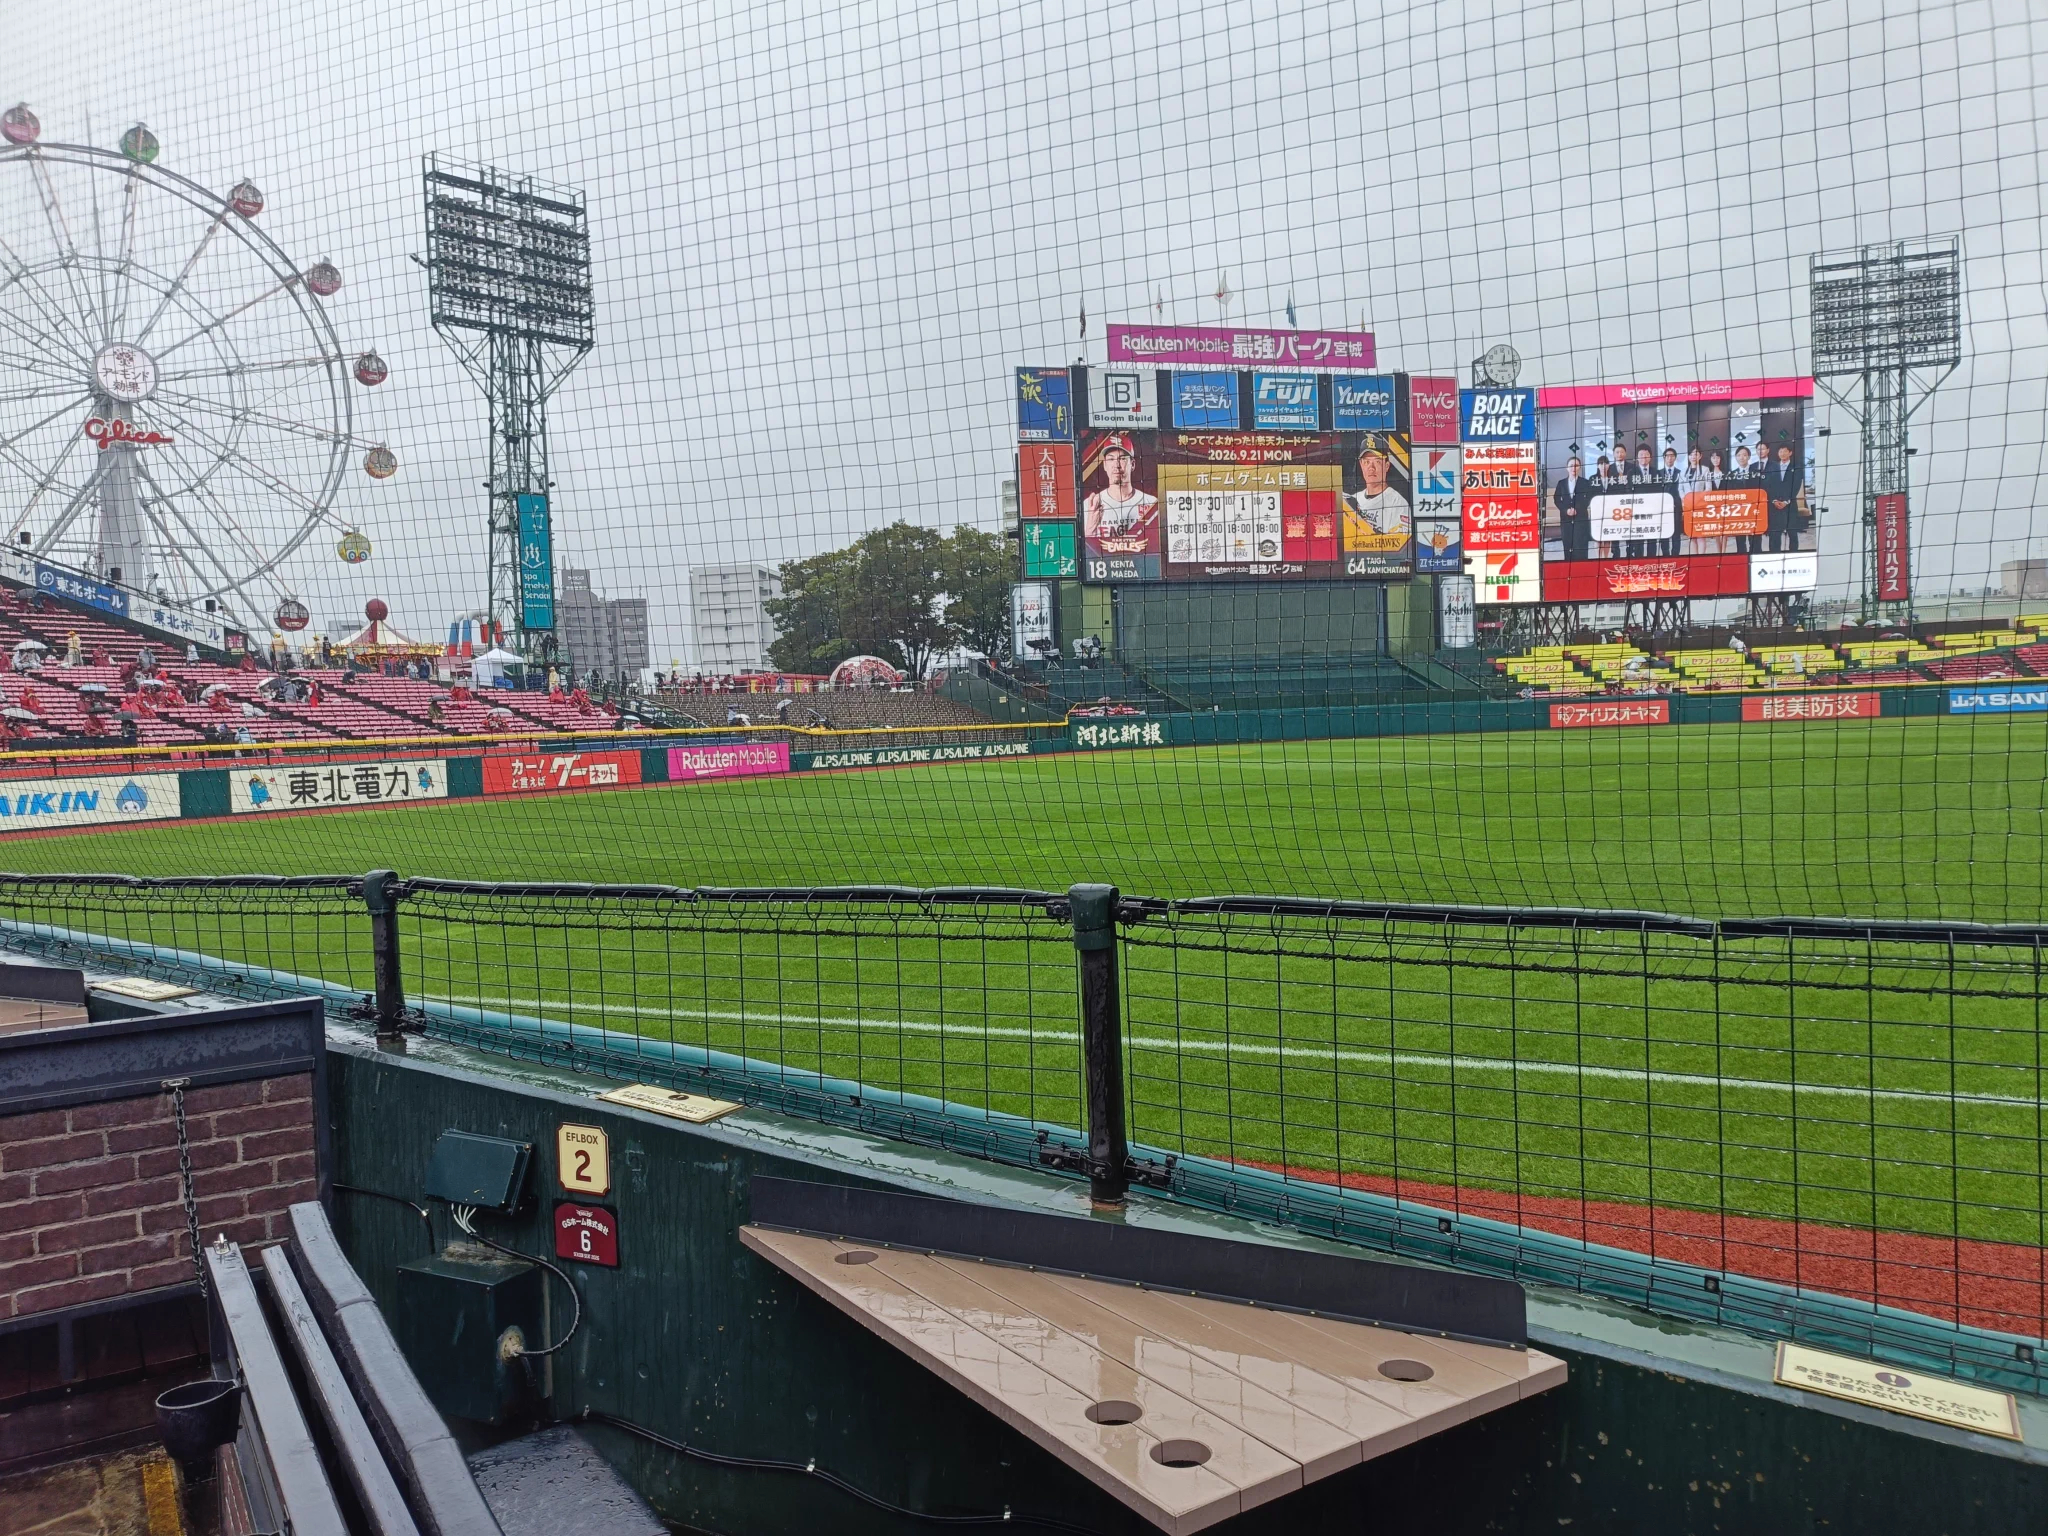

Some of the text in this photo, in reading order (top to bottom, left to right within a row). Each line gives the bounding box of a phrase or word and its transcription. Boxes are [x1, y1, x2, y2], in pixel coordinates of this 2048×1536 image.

[1121, 334, 1183, 354] Rakuten
[1185, 337, 1230, 353] Mobile
[102, 367, 150, 382] アーモンド
[113, 381, 141, 393] 効果
[1258, 377, 1314, 405] Fuji
[1621, 384, 1732, 400] Rakuten Mobile Vision
[1337, 385, 1390, 406] Yurtec
[1412, 391, 1455, 410] TWG
[1338, 408, 1390, 416] 株式会社 ユアテック
[1473, 394, 1527, 415] BOAT
[1094, 414, 1153, 422] Bloom Build
[1435, 412, 1451, 420] Work
[1469, 416, 1523, 435] RACE
[85, 418, 175, 450] Glico
[1207, 450, 1292, 461] 2026.9.21 MON
[1038, 447, 1057, 515] 大和証券
[1196, 471, 1307, 486] ホームゲーム日程
[1465, 469, 1534, 488] あいホーム
[1418, 498, 1455, 512] カメイ
[1705, 503, 1752, 519] 3,827
[1206, 513, 1214, 521] 水
[1235, 513, 1243, 521] 木
[1263, 513, 1272, 521] 土
[1469, 502, 1533, 528] Glico
[1612, 508, 1633, 521] 88
[1169, 524, 1194, 534] 18:00
[1198, 524, 1223, 534] 18:00
[1227, 523, 1251, 533] 18:00
[1255, 523, 1279, 533] 18:00
[1703, 521, 1757, 531] 業界トップクラス
[1351, 538, 1400, 549] SoftBank HAWKS
[1470, 531, 1533, 543] 遊びに行こう!
[1025, 524, 1075, 575] 清月記
[1102, 541, 1146, 553] EAGLES
[1884, 501, 1900, 592] 三井のリハウス
[1088, 561, 1107, 579] 18
[1110, 560, 1135, 568] KENTA
[1347, 557, 1366, 575] 64
[524, 574, 538, 582] spa
[1111, 570, 1139, 578] MAEDA
[55, 576, 124, 609] 東北ボール
[525, 591, 551, 600] Sendai
[1444, 602, 1472, 616] Asahi
[153, 609, 220, 641] 東北ボール
[1016, 611, 1049, 626] Asahi
[1762, 695, 1860, 719] 能美防災
[1951, 694, 1986, 708] 山九
[1576, 706, 1661, 722] アイリスオーヤマ
[1075, 722, 1163, 746] 河北新報
[511, 759, 545, 776] カー!
[682, 748, 777, 774] Rakuten Mobile
[288, 766, 409, 804] 東北電力
[511, 775, 546, 789] と言えば
[565, 1132, 599, 1145] EFLBOX
[574, 1149, 592, 1183] 2
[562, 1218, 609, 1236] GSホーム株式会社
[580, 1229, 592, 1252] 6
[1793, 1364, 2000, 1419] 身を乗りださないでください
[1807, 1373, 1986, 1423] 物を置かないでください
